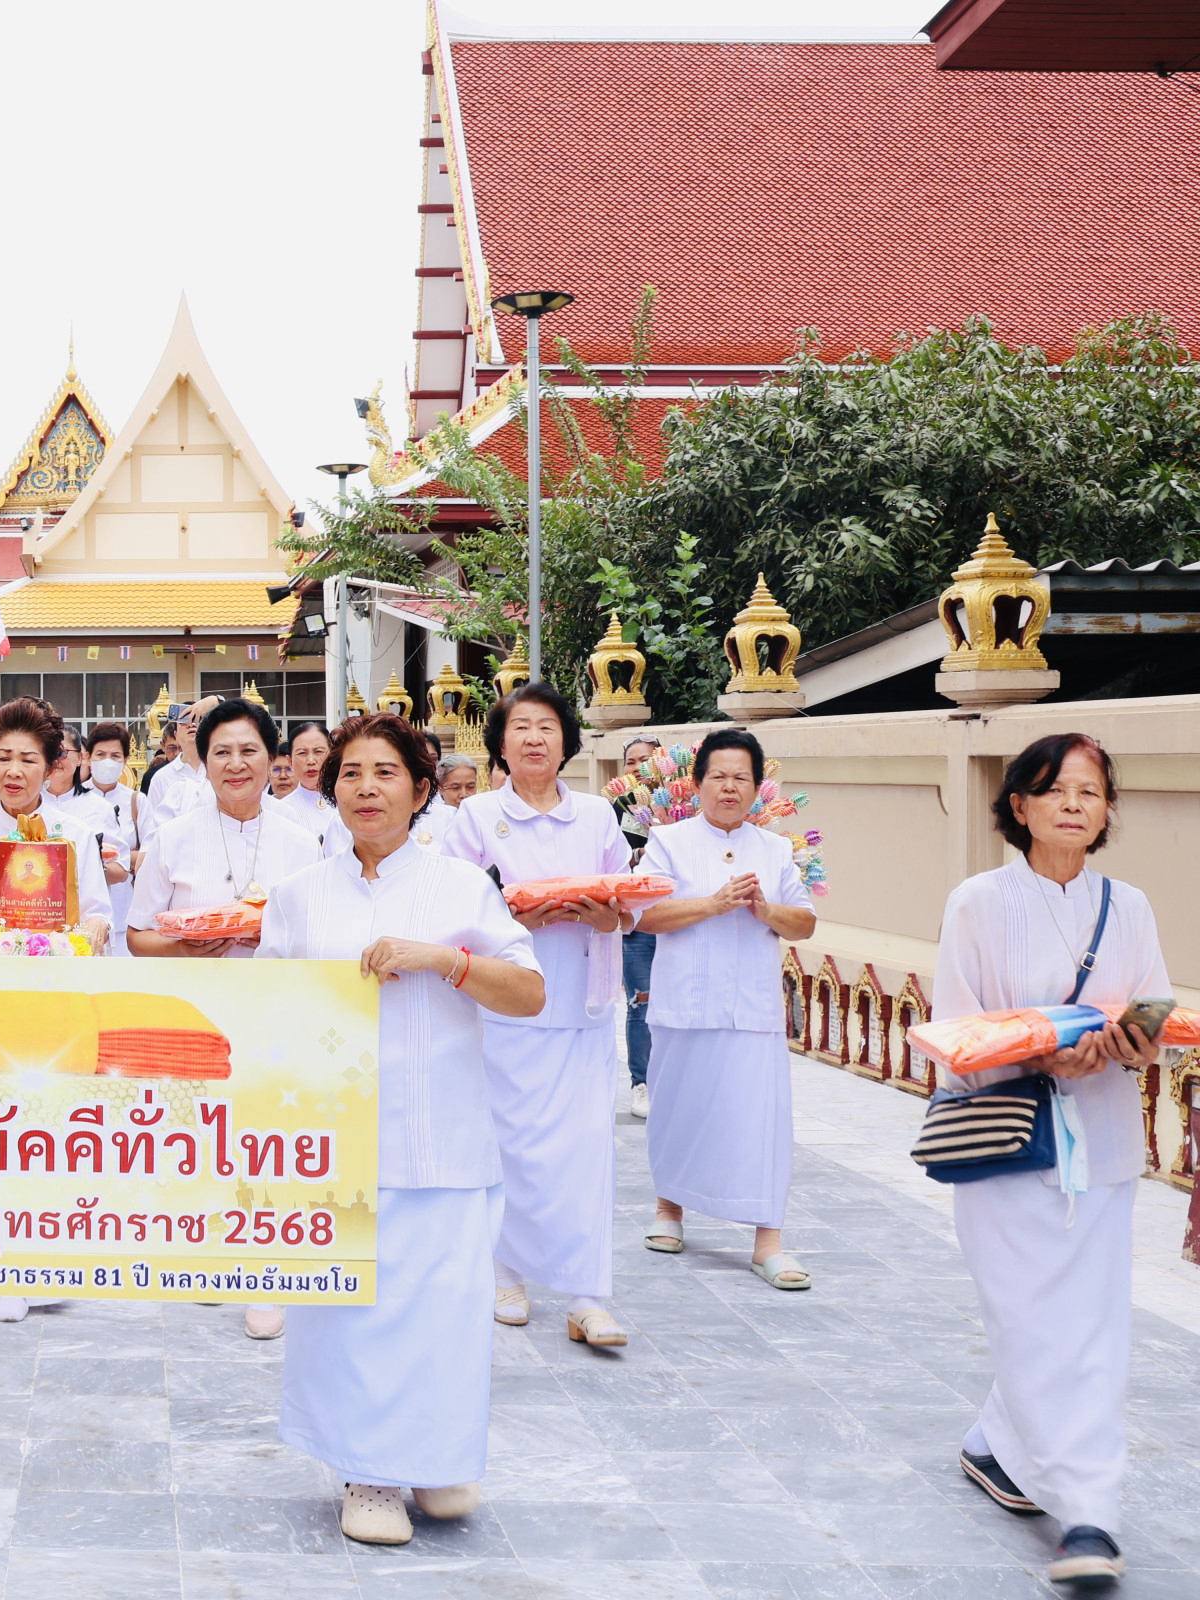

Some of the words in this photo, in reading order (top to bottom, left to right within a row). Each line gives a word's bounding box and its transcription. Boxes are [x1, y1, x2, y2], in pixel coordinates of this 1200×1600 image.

[224, 1210, 334, 1246] 2568
[93, 1268, 122, 1287] 81
[133, 1263, 149, 1287] ปี
[159, 1267, 358, 1292] หลวงพ่อธัมมชโย
